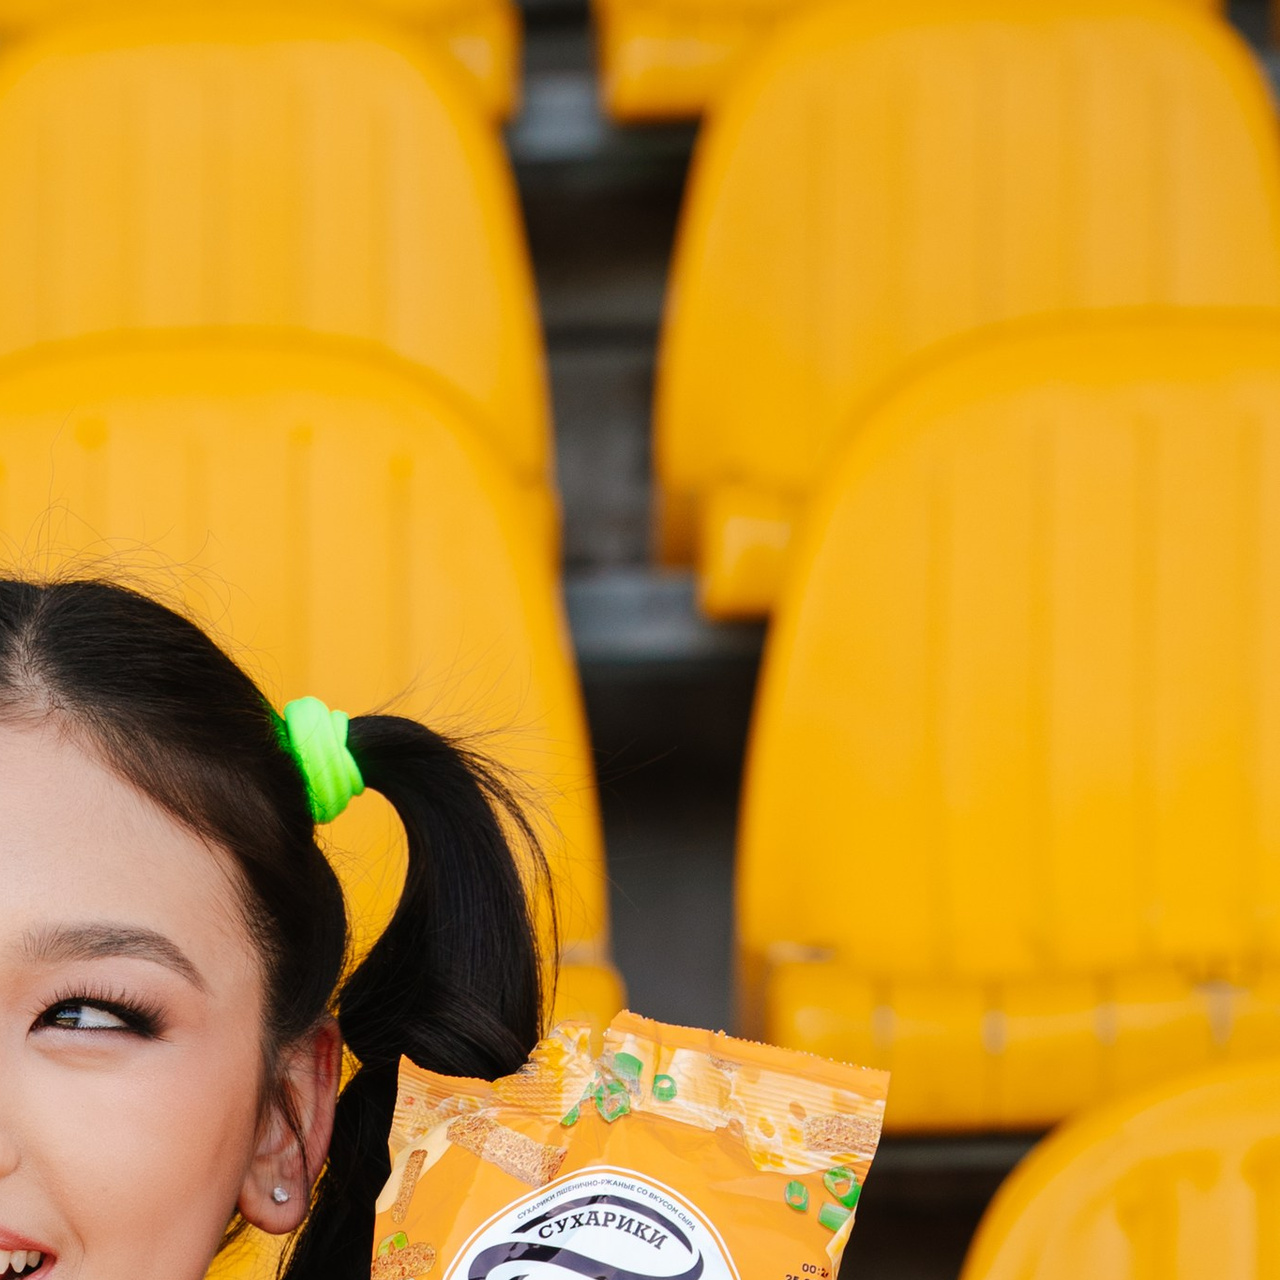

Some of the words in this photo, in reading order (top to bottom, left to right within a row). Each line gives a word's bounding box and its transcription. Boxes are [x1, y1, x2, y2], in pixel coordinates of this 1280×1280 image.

[517, 1193, 555, 1220] СУХАРИКИ
[636, 1186, 648, 1196] СО
[648, 1191, 679, 1215] ВКУСОМ
[677, 1212, 696, 1232] СЫРА
[538, 1210, 669, 1250] СУХАРИКИ
